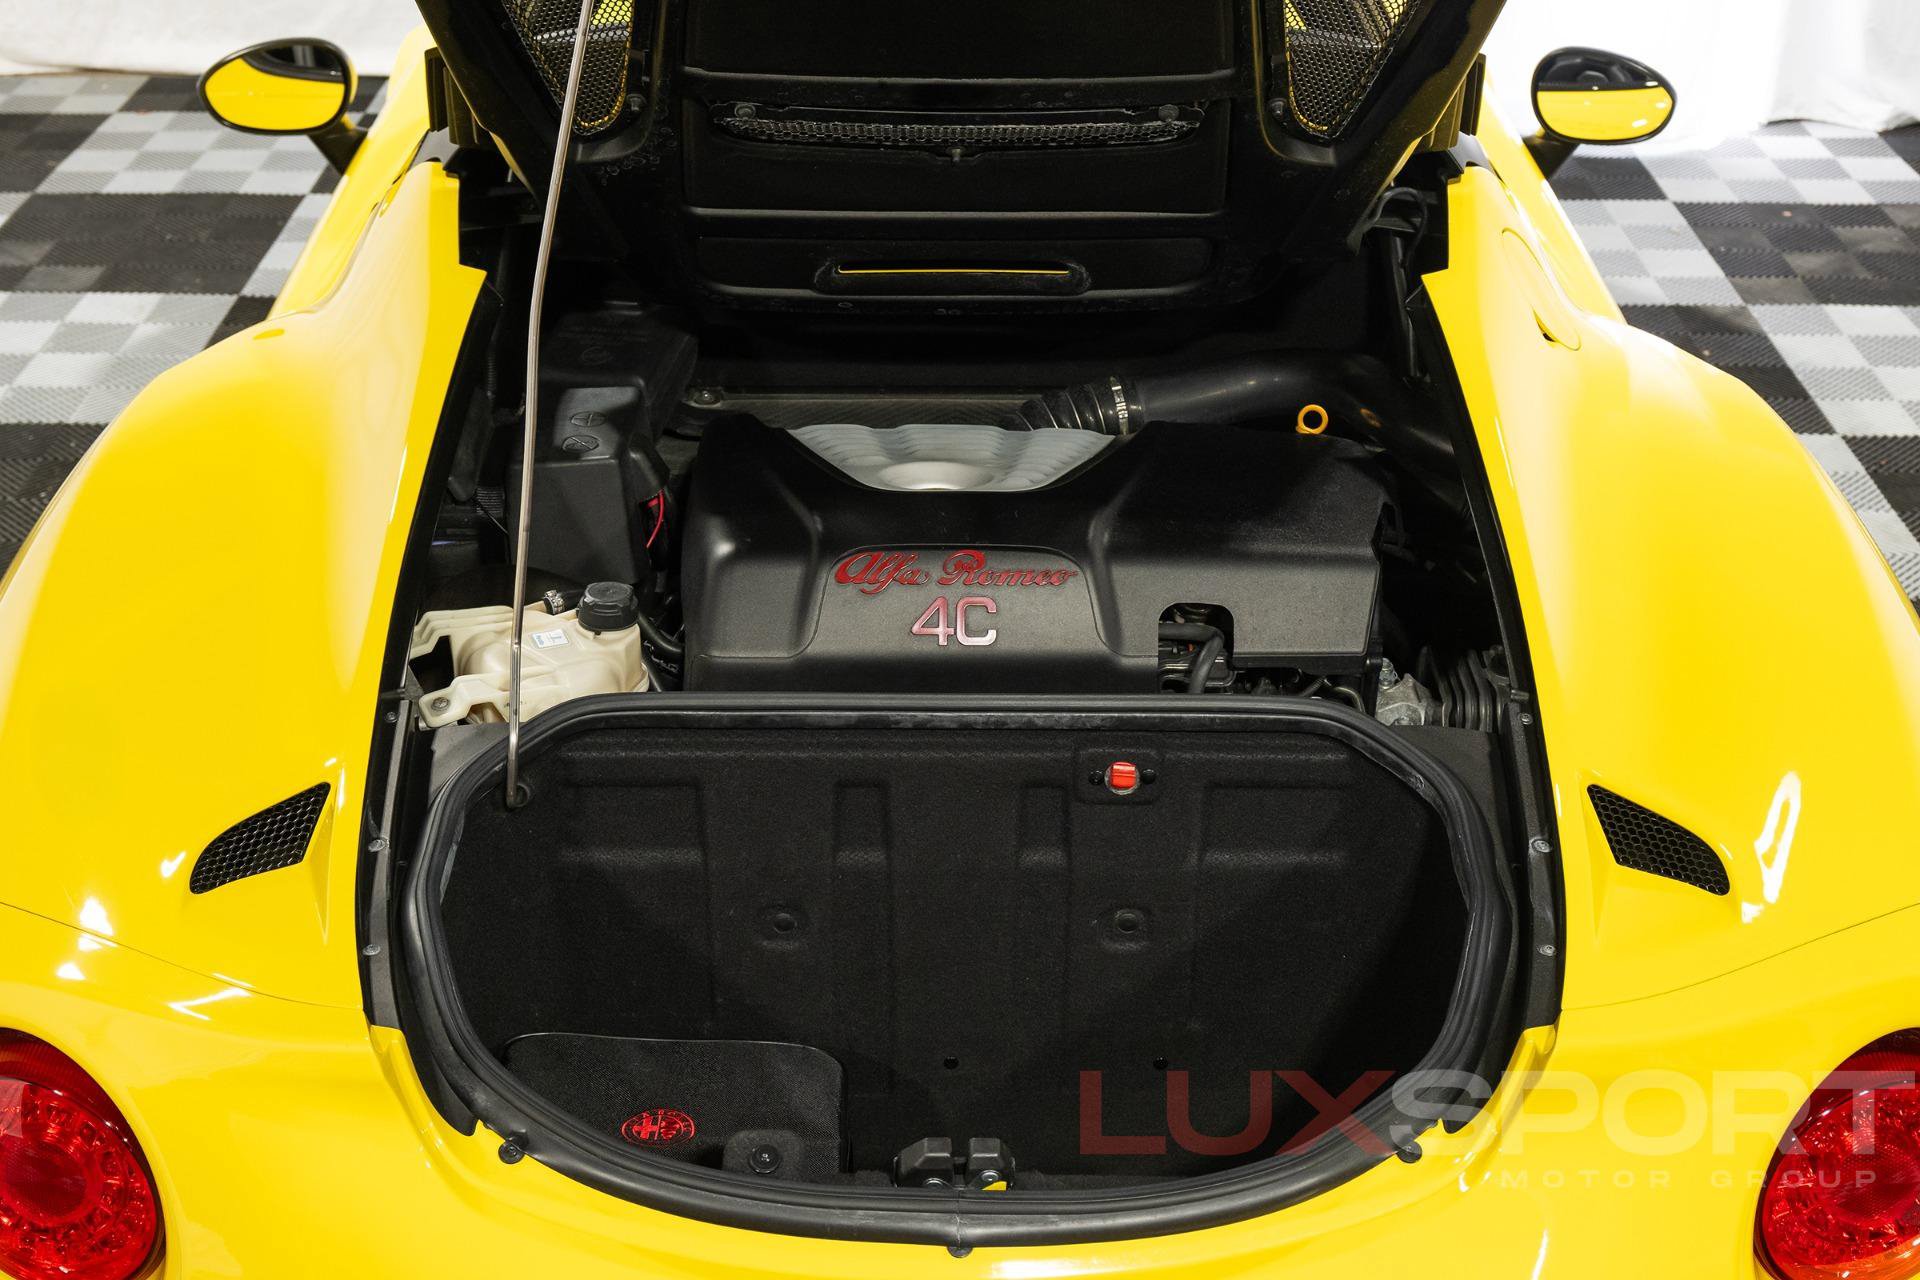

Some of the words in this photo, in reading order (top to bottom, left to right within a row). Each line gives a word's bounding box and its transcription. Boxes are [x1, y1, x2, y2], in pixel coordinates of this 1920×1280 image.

[834, 550, 930, 595] Alfa
[936, 549, 1079, 587] Romeo
[910, 595, 998, 647] 4C
